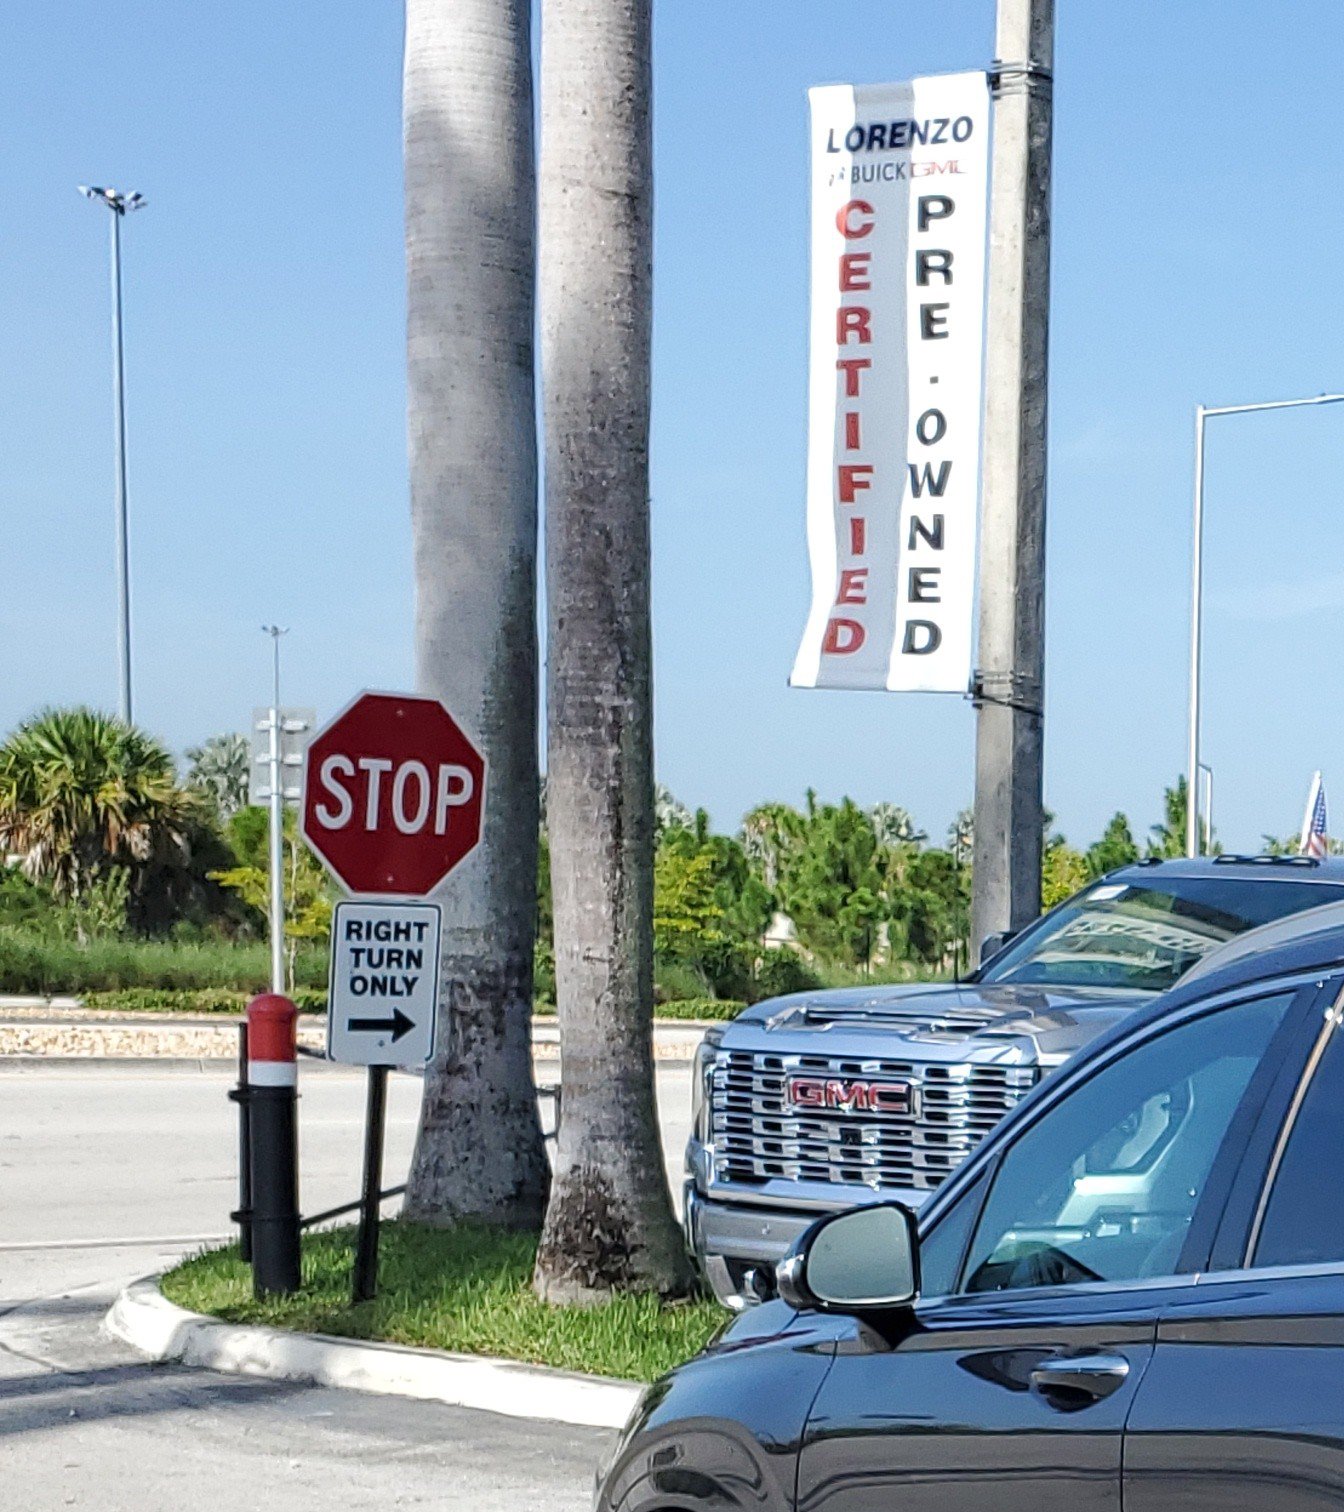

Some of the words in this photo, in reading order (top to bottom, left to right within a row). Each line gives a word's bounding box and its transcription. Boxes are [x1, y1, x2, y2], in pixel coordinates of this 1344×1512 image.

[826, 116, 973, 154] LORENZO
[851, 161, 906, 184] BUICK
[822, 199, 875, 655] CERTIFIED
[315, 753, 474, 836] STOP
[345, 919, 430, 943] RIGHT
[350, 947, 423, 970] TURN
[349, 974, 420, 997] ONLY
[790, 1078, 909, 1113] GMC
